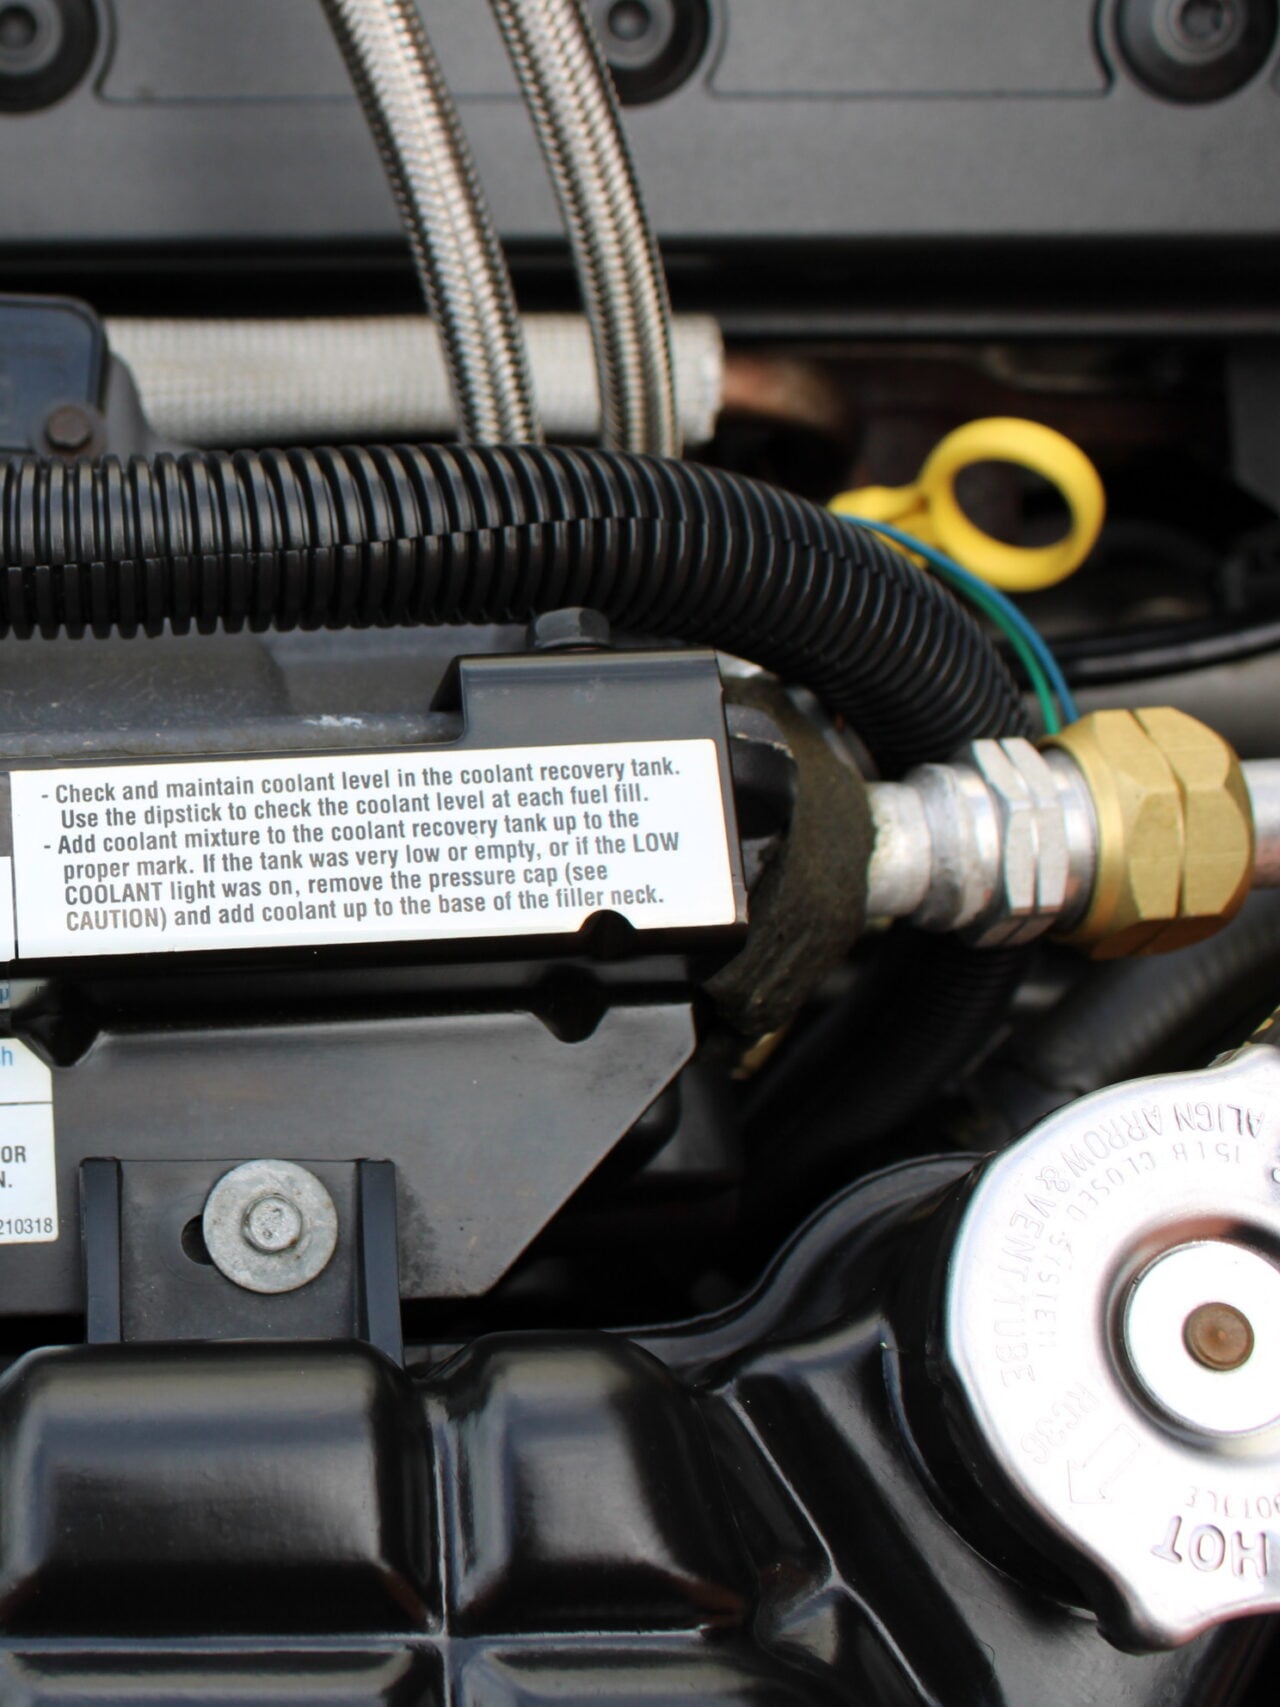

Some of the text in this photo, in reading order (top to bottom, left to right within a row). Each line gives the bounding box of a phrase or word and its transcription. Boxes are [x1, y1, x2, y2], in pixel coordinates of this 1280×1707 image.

[55, 756, 680, 804] Check and maintain coolant level in the coolant recovery tank.
[57, 808, 640, 855] Add coolant mixture to the coolant recovery tank up to the
[66, 883, 664, 932] CAUTION) and add coolant up to the base of the filler neck.
[1061, 1105, 1162, 1178] ARROW
[1173, 1102, 1265, 1138] ALIGN
